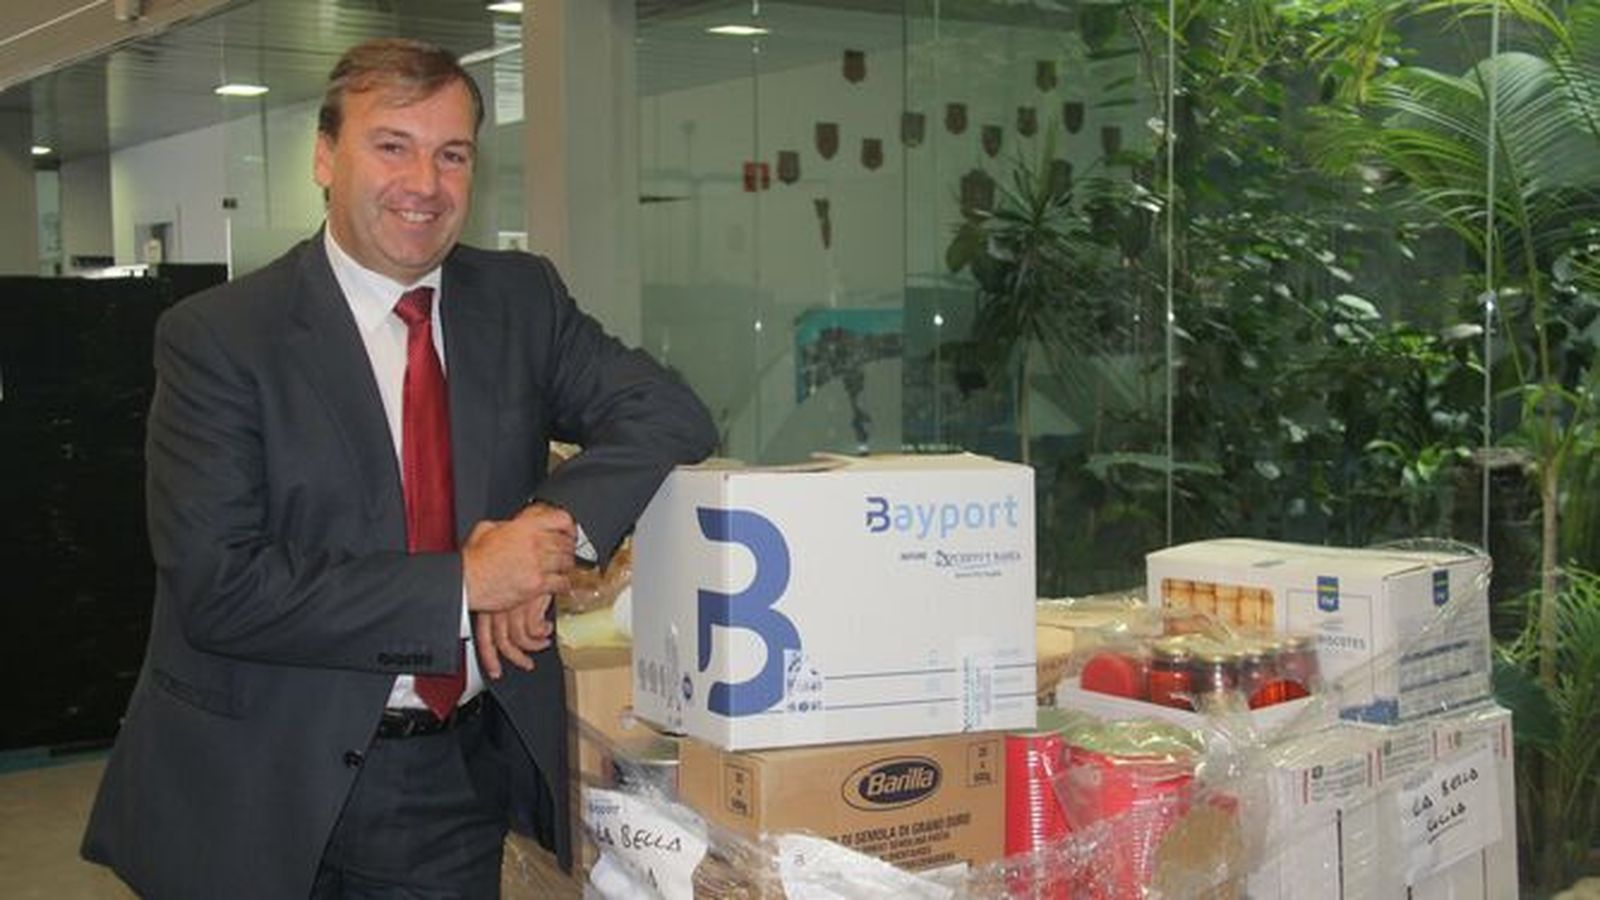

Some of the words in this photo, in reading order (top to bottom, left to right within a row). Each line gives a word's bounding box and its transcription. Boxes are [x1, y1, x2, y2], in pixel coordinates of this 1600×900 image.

[866, 495, 1018, 538] Bayport
[867, 767, 935, 797] Barilla
[620, 823, 682, 851] BELLA
